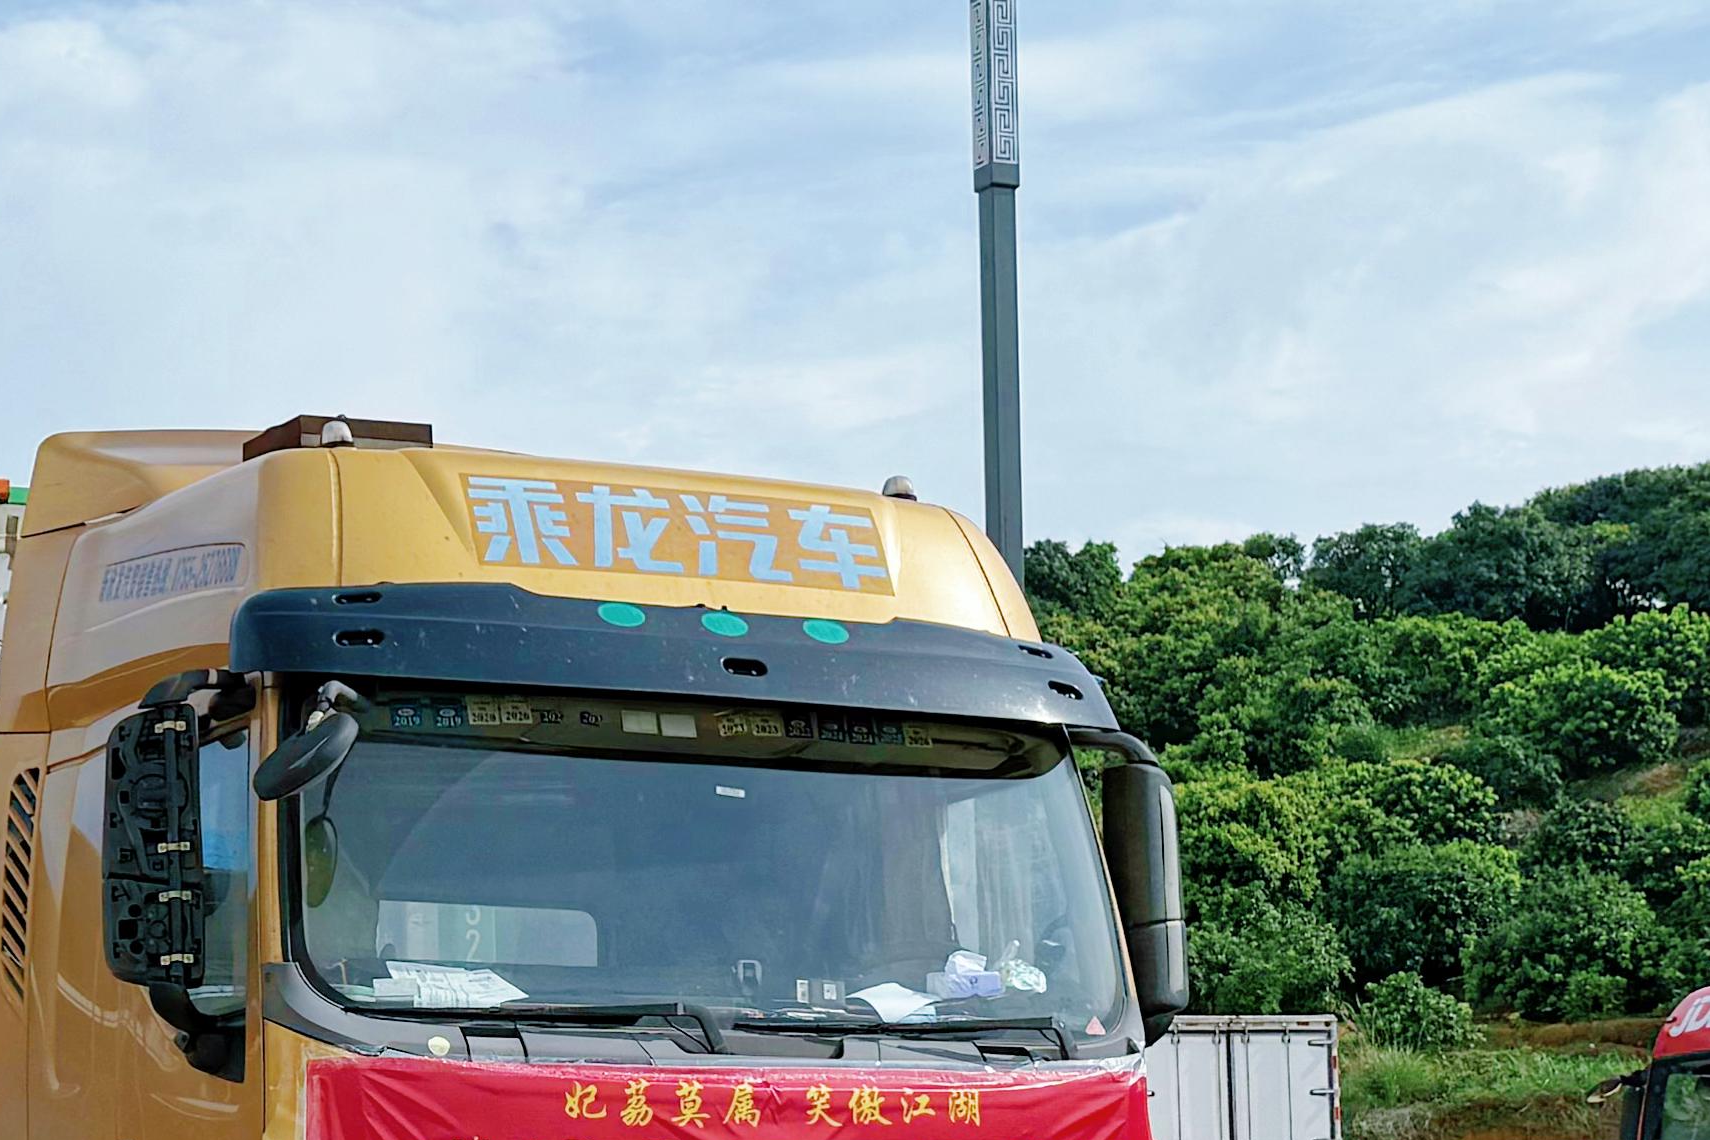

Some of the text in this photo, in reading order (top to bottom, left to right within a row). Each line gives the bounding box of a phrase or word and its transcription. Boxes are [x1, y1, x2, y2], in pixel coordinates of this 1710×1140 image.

[467, 476, 888, 589] 乘龙汽车
[564, 1080, 982, 1129] 妃荔莫属 笑傲江湖
